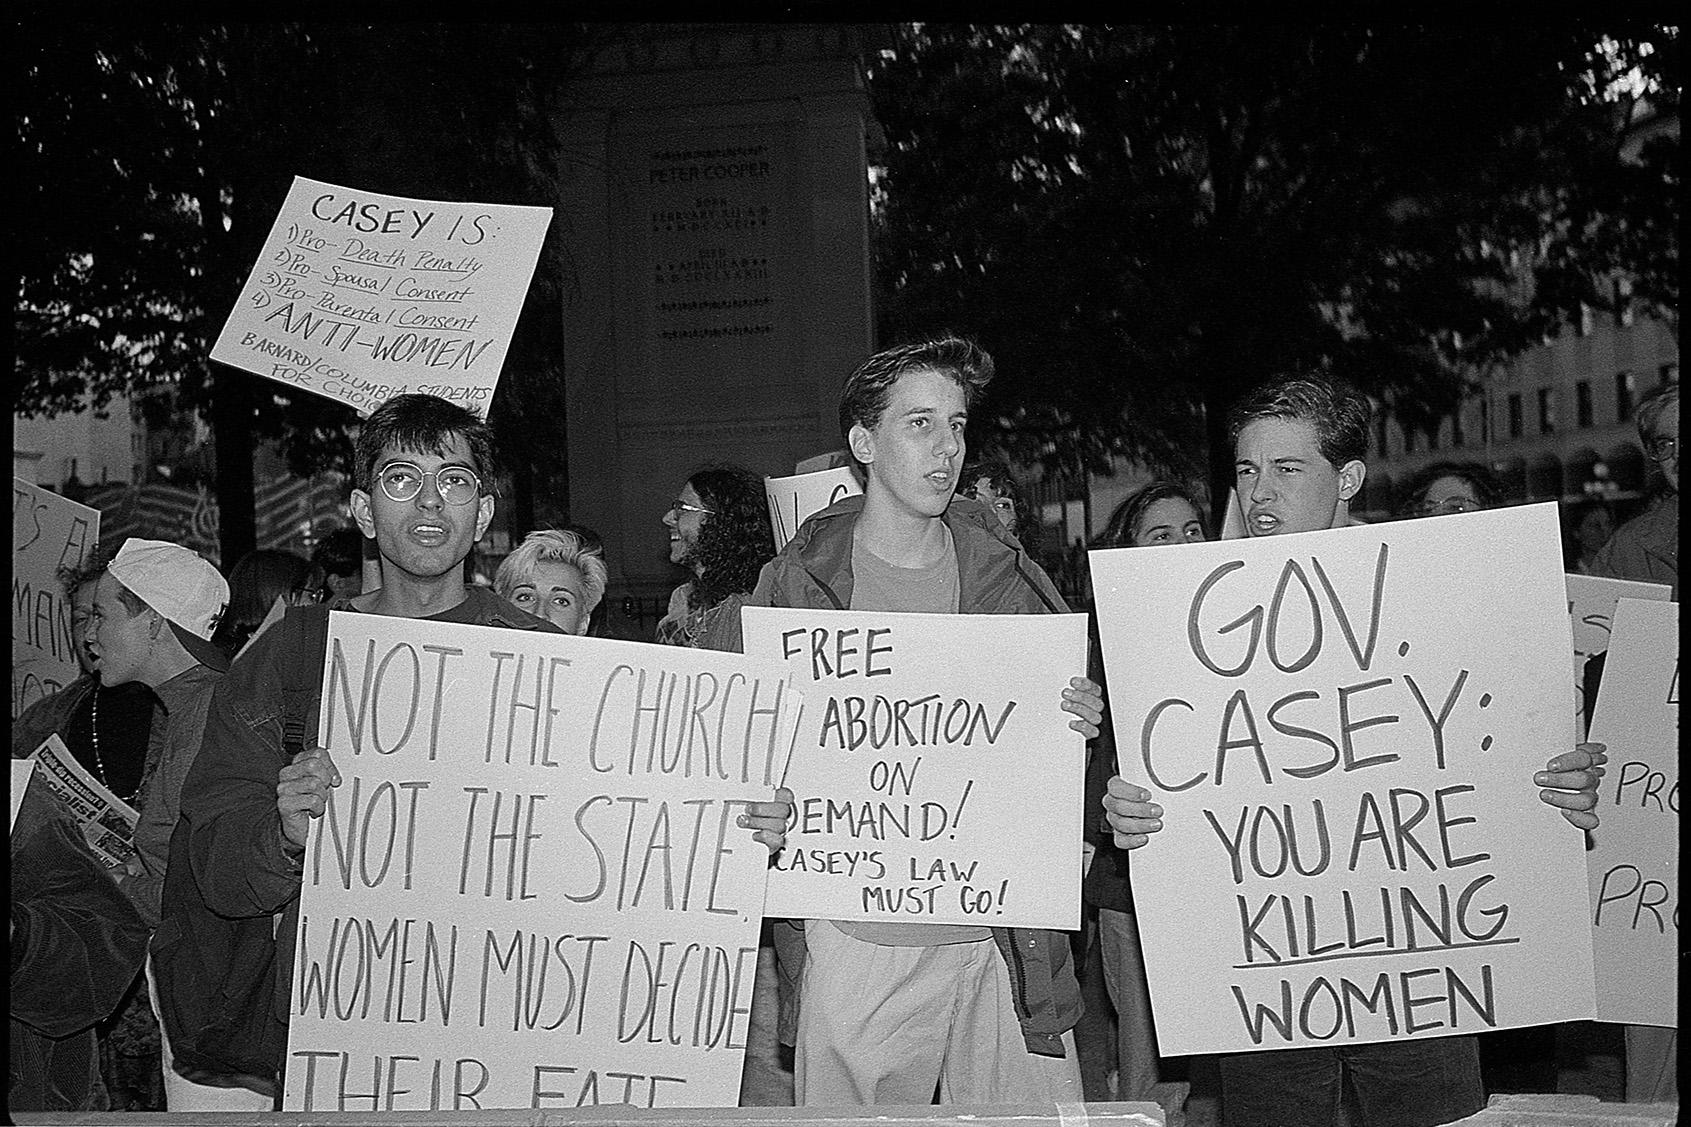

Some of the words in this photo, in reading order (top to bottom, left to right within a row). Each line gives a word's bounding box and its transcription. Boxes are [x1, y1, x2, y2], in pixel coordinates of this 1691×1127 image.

[650, 166, 699, 184] PETER
[704, 162, 770, 180] COOPER
[312, 194, 435, 240] CASEY
[446, 214, 501, 246] IS:
[324, 265, 392, 288] Spousal
[396, 277, 475, 301] Consent
[341, 238, 406, 267] Death
[414, 250, 483, 283] Penalty
[264, 302, 494, 370] ANTI-WOMEN
[316, 290, 396, 325] Parental
[398, 306, 479, 330] Consent
[271, 363, 312, 386] FOR
[322, 380, 381, 411] CHOIC
[416, 384, 493, 400] STUDENTS
[1187, 542, 1411, 678] GOV.
[782, 628, 893, 681] FREE
[325, 638, 464, 756] NOT
[486, 651, 572, 768] THE
[819, 694, 1017, 752] ABORTION
[1140, 669, 1494, 793] CASEY:
[870, 756, 922, 796] ON
[312, 776, 431, 891] NOT
[458, 786, 549, 901] THE
[1202, 798, 1332, 884] YOU
[1348, 784, 1491, 872] ARE
[777, 847, 886, 880] CASEY'S
[910, 856, 978, 883] LAW
[862, 884, 945, 914] MUST
[960, 880, 1009, 916] GO!
[1236, 874, 1511, 963] KILLING
[1594, 864, 1678, 934] PR
[300, 915, 457, 1027] WOMEN
[479, 929, 611, 1035] MUST
[618, 940, 757, 1053] DECIDE
[1230, 964, 1498, 1045] WOMEN
